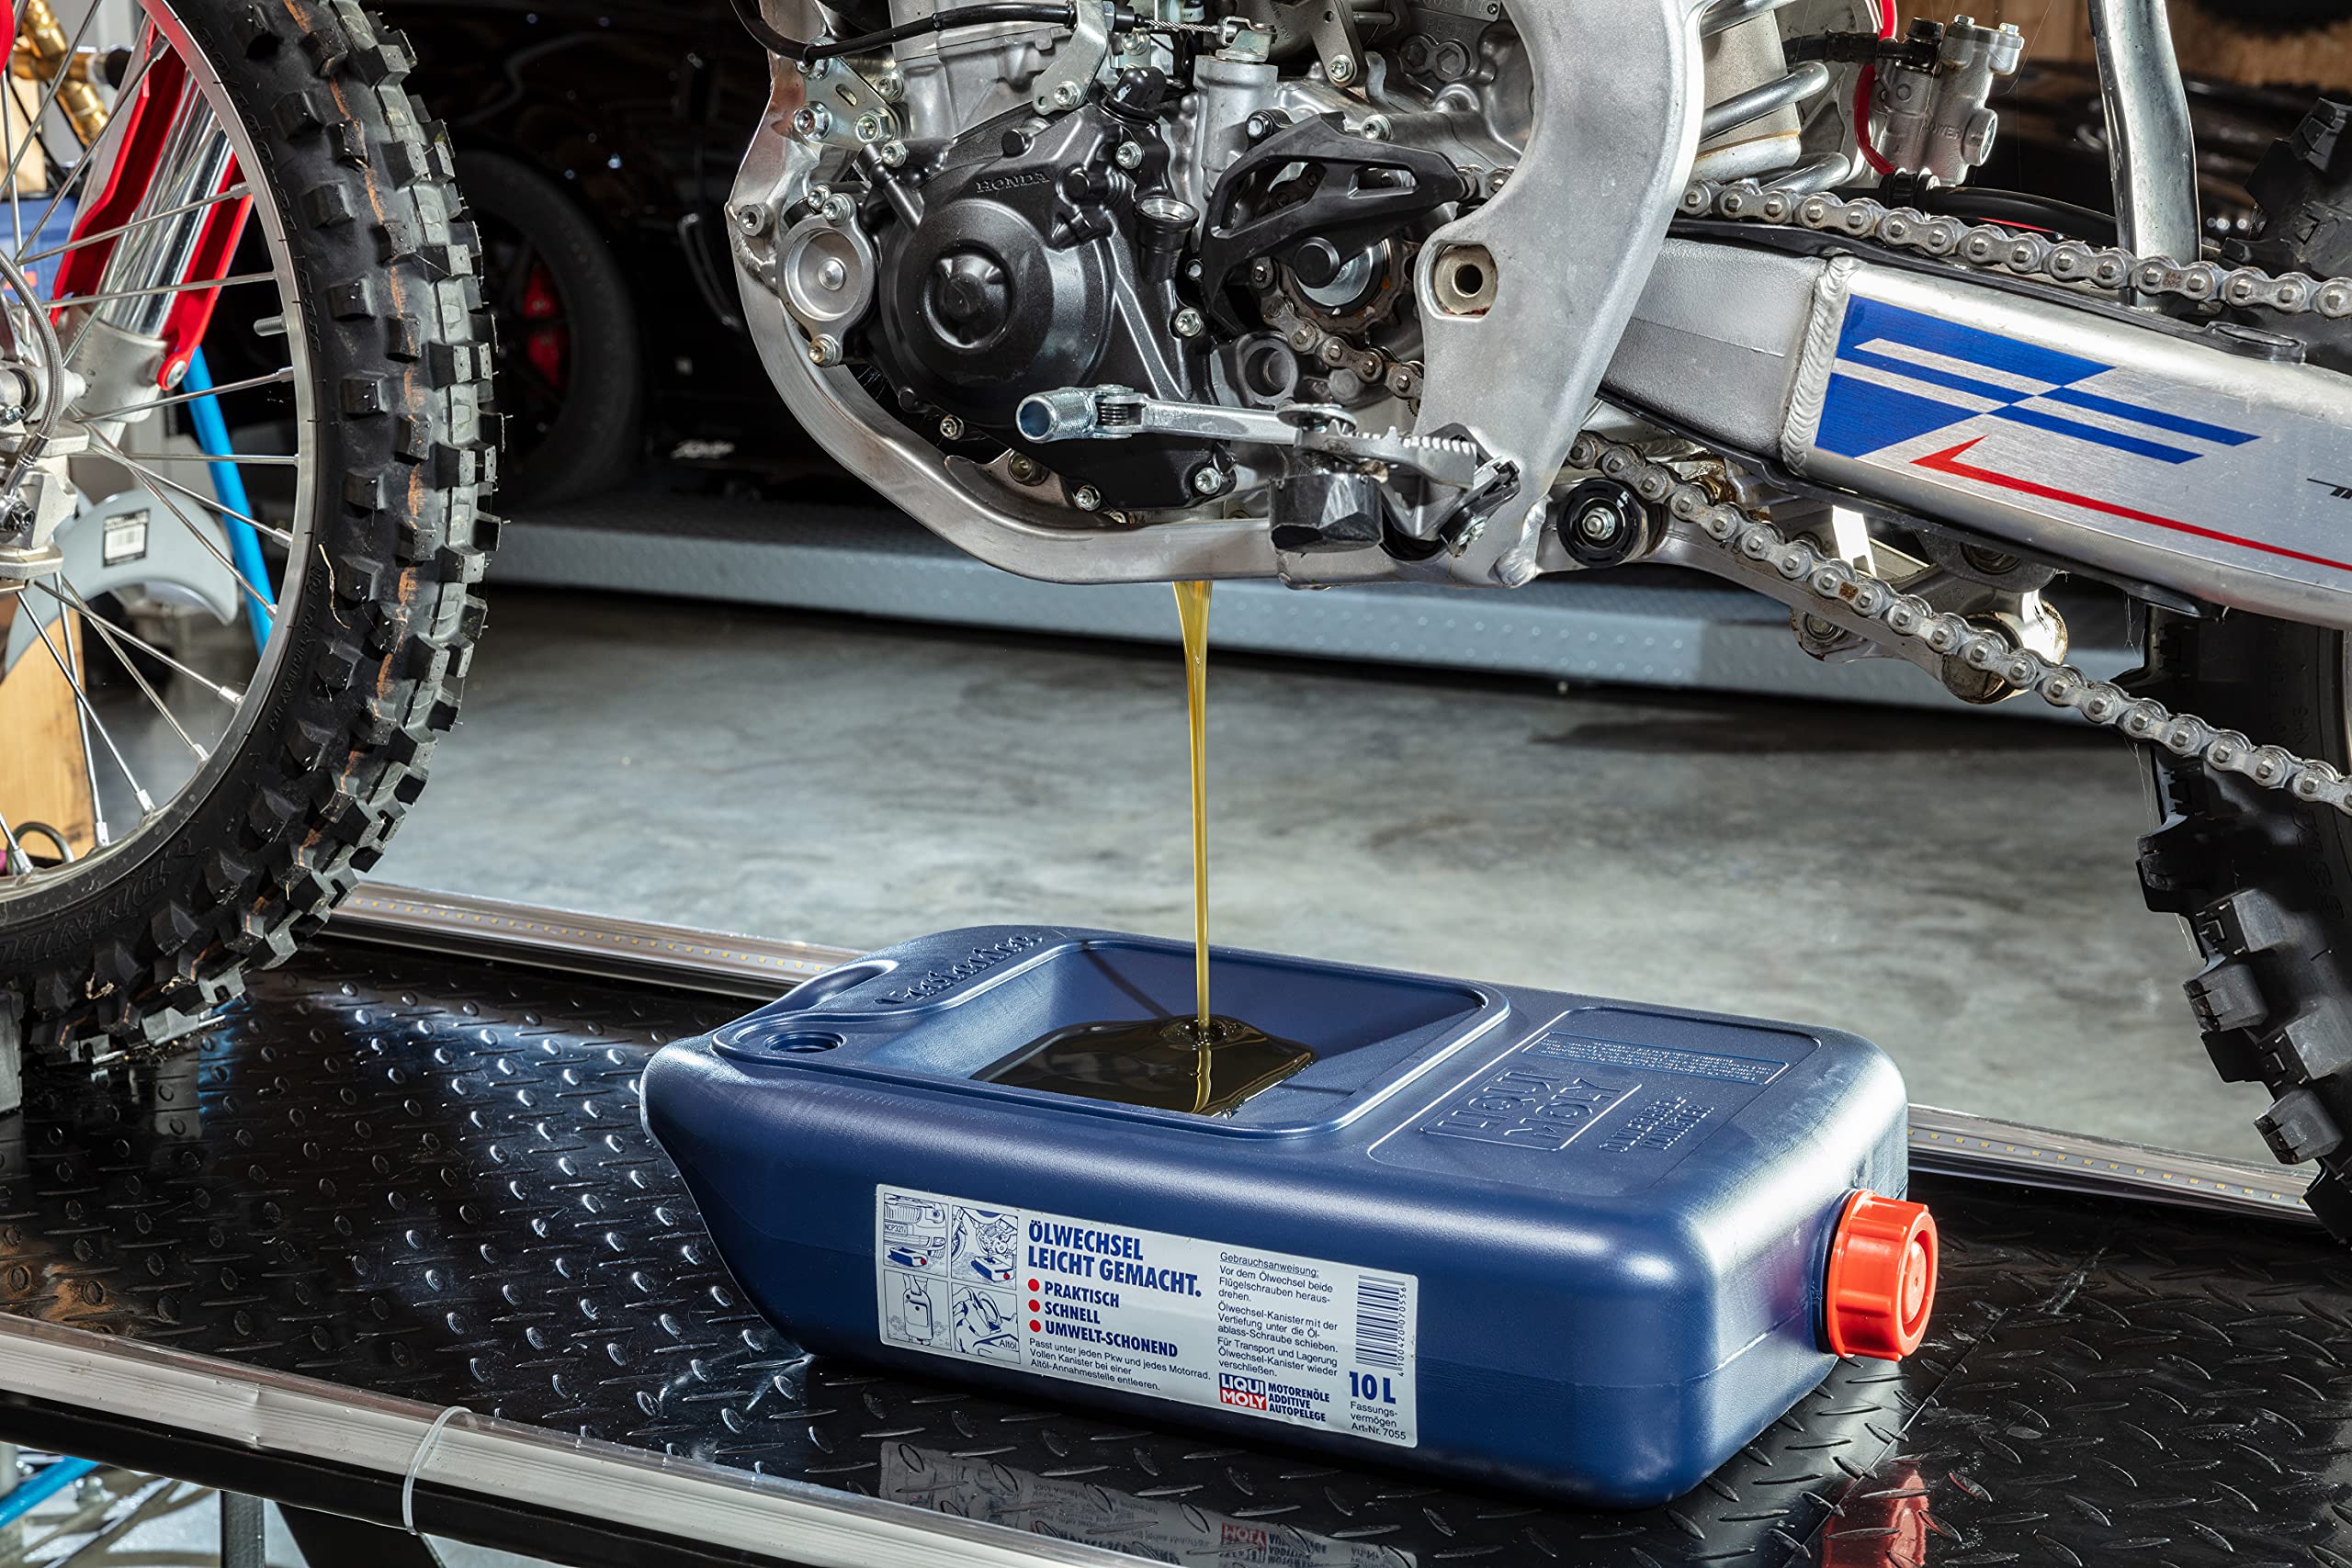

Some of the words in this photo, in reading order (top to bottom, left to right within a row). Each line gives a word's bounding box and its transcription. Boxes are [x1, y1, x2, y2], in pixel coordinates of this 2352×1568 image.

[976, 172, 1052, 194] HONDA
[1437, 1072, 1560, 1131] LIQUI
[1504, 1077, 1623, 1139] MOLY
[1028, 1219, 1144, 1261] ÖLWECHSEL
[1027, 1245, 1095, 1278] LEICHT
[1099, 1258, 1202, 1298] GEMACHT.
[1219, 1251, 1319, 1279] Gebrauchsanweisung:
[1219, 1265, 1235, 1276] Vor
[1236, 1269, 1256, 1280] dem
[1259, 1270, 1306, 1288] Ölwechsel
[1307, 1280, 1333, 1293] beide
[1219, 1276, 1294, 1298] Flügelschrauben
[1295, 1290, 1330, 1303] heraus-
[1044, 1280, 1120, 1309] PRAKTISCH
[1218, 1288, 1251, 1302] drehen.
[1044, 1301, 1101, 1325] SCHNELL
[1217, 1301, 1305, 1325] Ölwechsel-Kanister
[1306, 1318, 1321, 1328] mit
[1322, 1321, 1338, 1331] der
[1217, 1313, 1263, 1331] Vertiefung
[1265, 1323, 1288, 1333] unter
[1291, 1326, 1305, 1337] die
[1306, 1327, 1320, 1338] Öl-
[998, 1338, 1017, 1350] Altöl
[1045, 1319, 1178, 1358] UMWELT-SCHONEND
[1217, 1325, 1293, 1345] ablass-Schraube
[1295, 1338, 1339, 1353] schieben.
[1029, 1337, 1053, 1350] Passt
[1054, 1344, 1077, 1354] unter
[1078, 1347, 1102, 1359] jeden
[1104, 1351, 1123, 1363] Pkw
[1124, 1358, 1141, 1367] und
[1142, 1359, 1168, 1372] jedes
[1169, 1364, 1211, 1381] Motorrad.
[1029, 1348, 1057, 1360] Vollen
[1057, 1353, 1093, 1368] Kanister
[1094, 1360, 1108, 1371] bei
[1110, 1364, 1132, 1375] einer
[1217, 1336, 1232, 1348] Für
[1234, 1338, 1275, 1355] Transport
[1277, 1348, 1295, 1359] und
[1295, 1350, 1338, 1369] Lagerung
[1218, 1346, 1305, 1371] Ölwechsel-Kanister
[1306, 1364, 1338, 1377] wieder
[1030, 1359, 1115, 1382] Altöl-Annahmestelle
[1116, 1376, 1160, 1391] entleeren.
[1218, 1359, 1277, 1377] verschließen.
[1221, 1375, 1265, 1393] LIQUI
[1268, 1382, 1330, 1403] MOTORENÖLE
[1349, 1371, 1378, 1401] 10
[1383, 1376, 1396, 1404] L
[1222, 1390, 1265, 1409] MOLY
[1268, 1393, 1311, 1410] ADDITIVE
[1350, 1400, 1398, 1418] Fassungs-
[1350, 1413, 1397, 1428] vermögen
[1382, 1427, 1407, 1440] 7055
